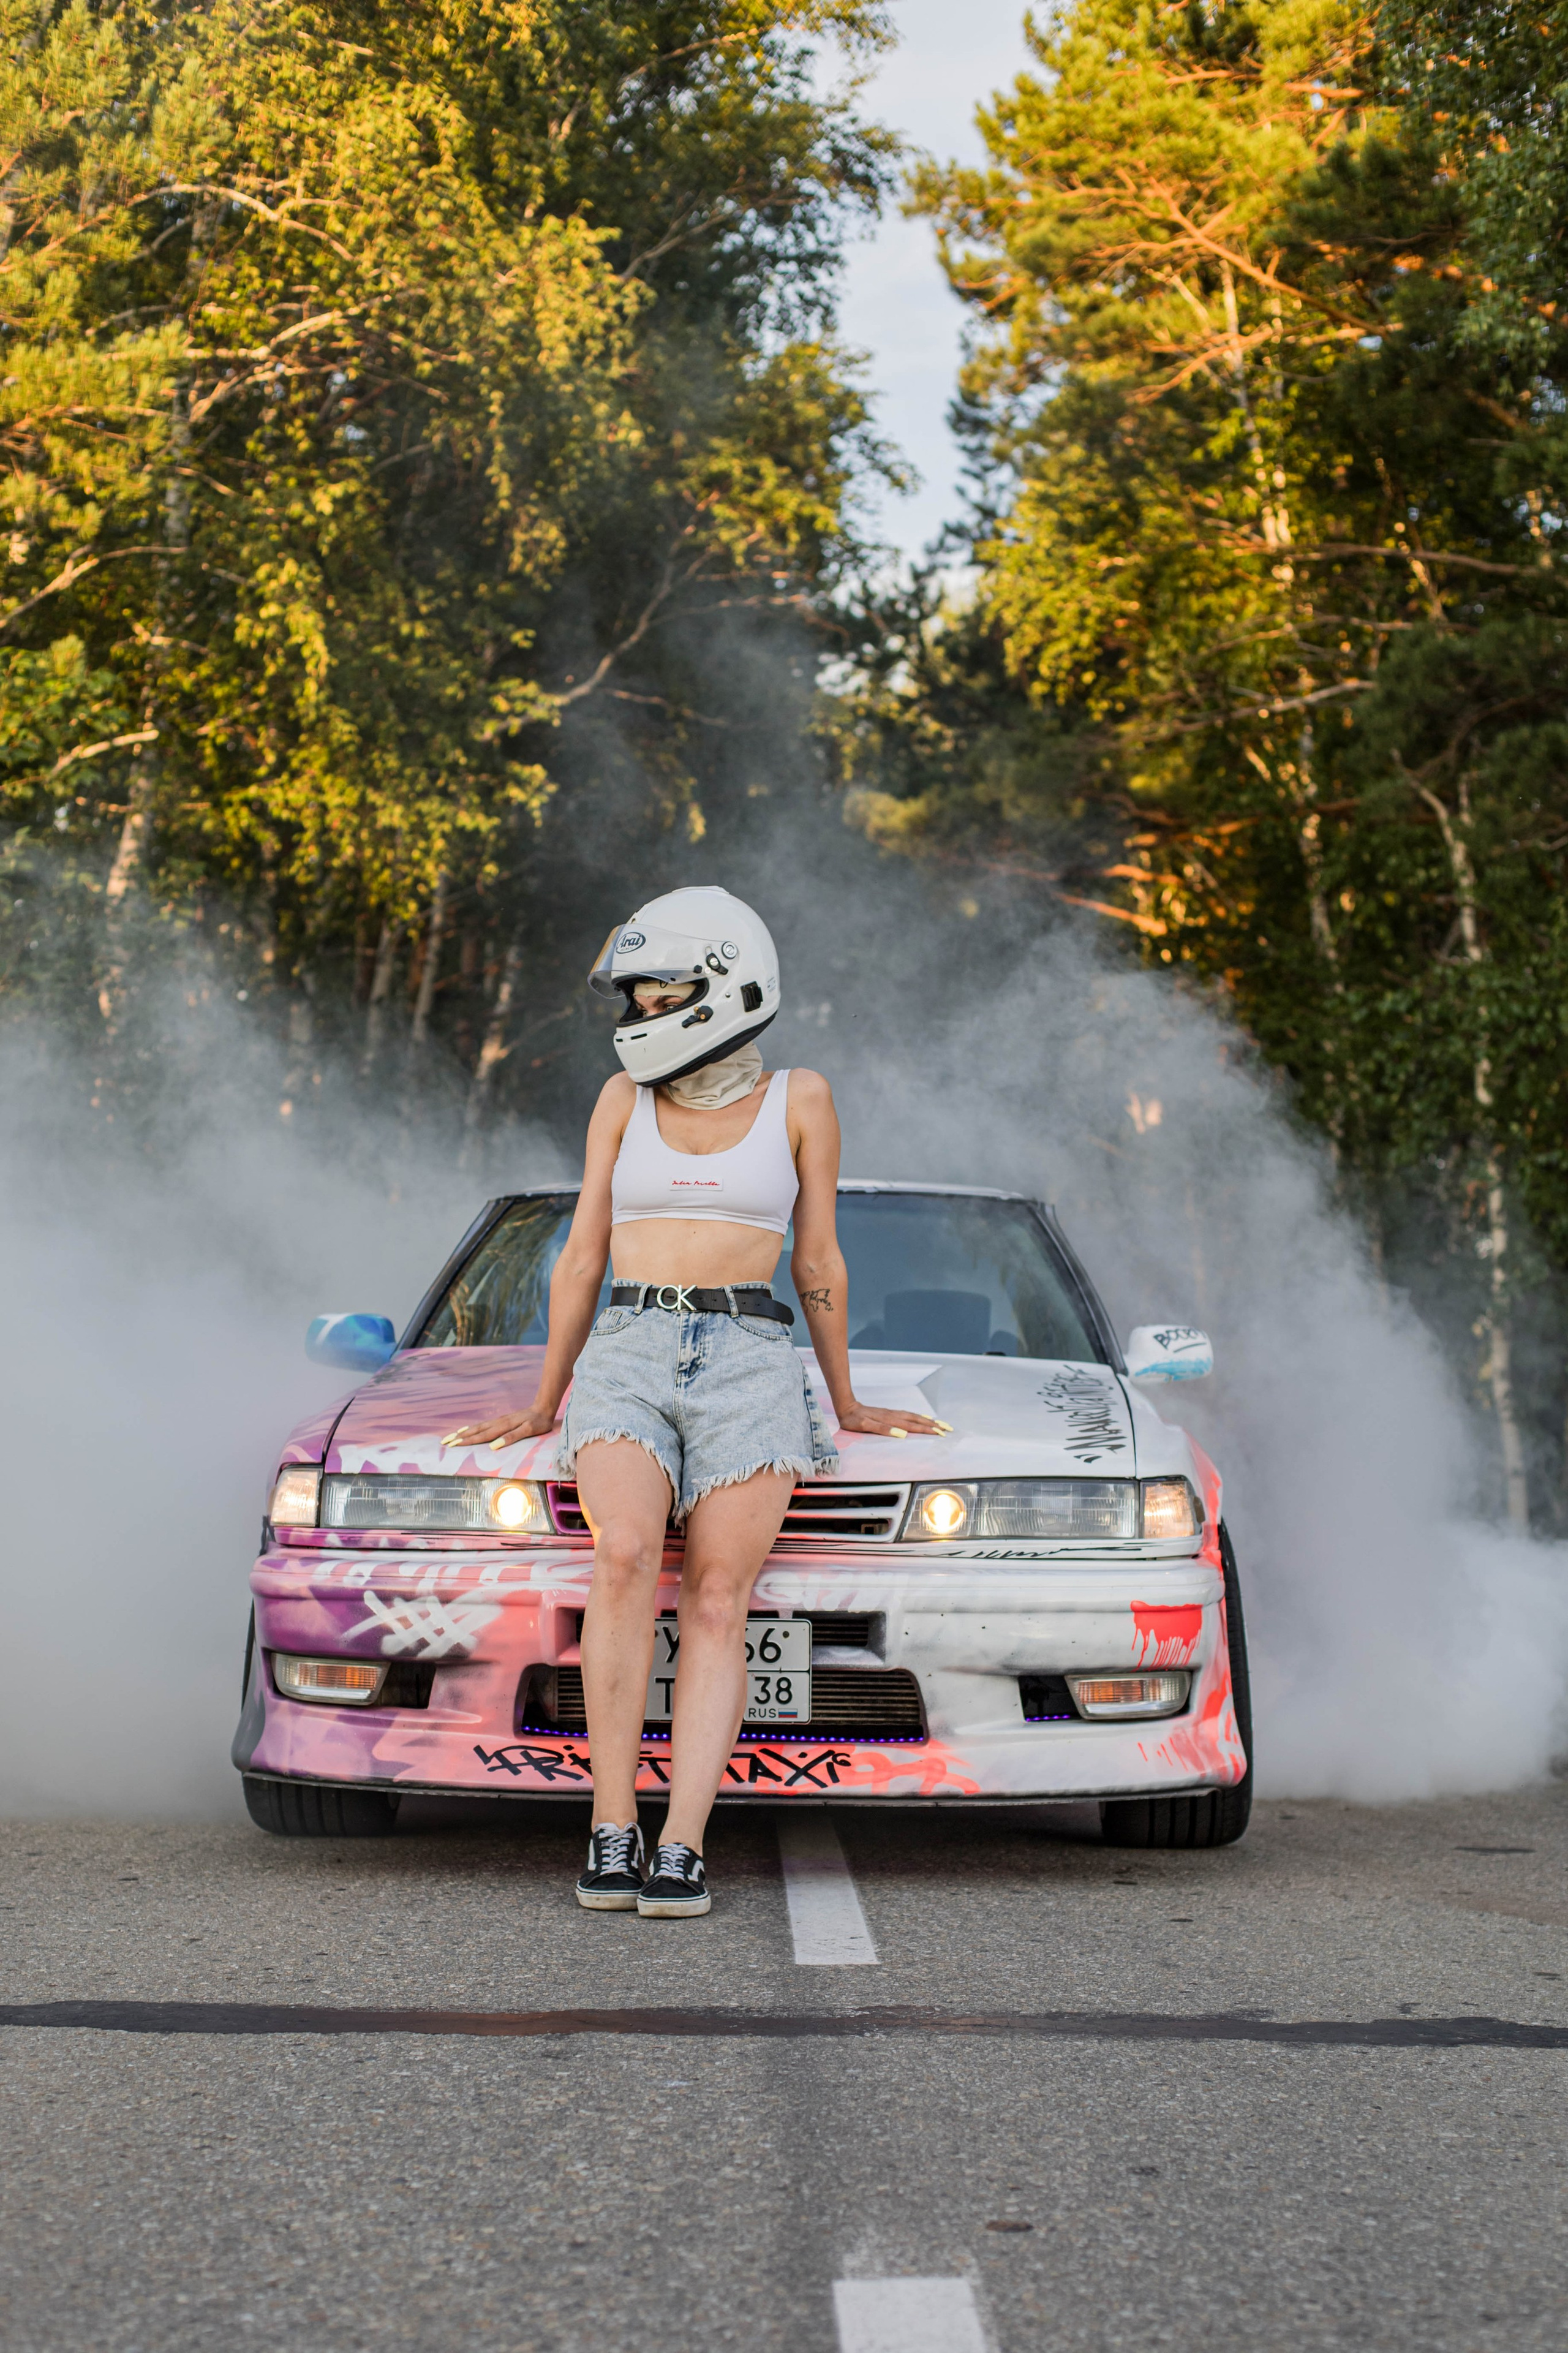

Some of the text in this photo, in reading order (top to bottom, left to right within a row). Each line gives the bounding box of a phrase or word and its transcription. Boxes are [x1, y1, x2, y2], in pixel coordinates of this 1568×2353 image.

[620, 934, 641, 948] Arai
[657, 1285, 697, 1311] CK
[754, 1676, 793, 1705] 38
[748, 1707, 777, 1718] RUS
